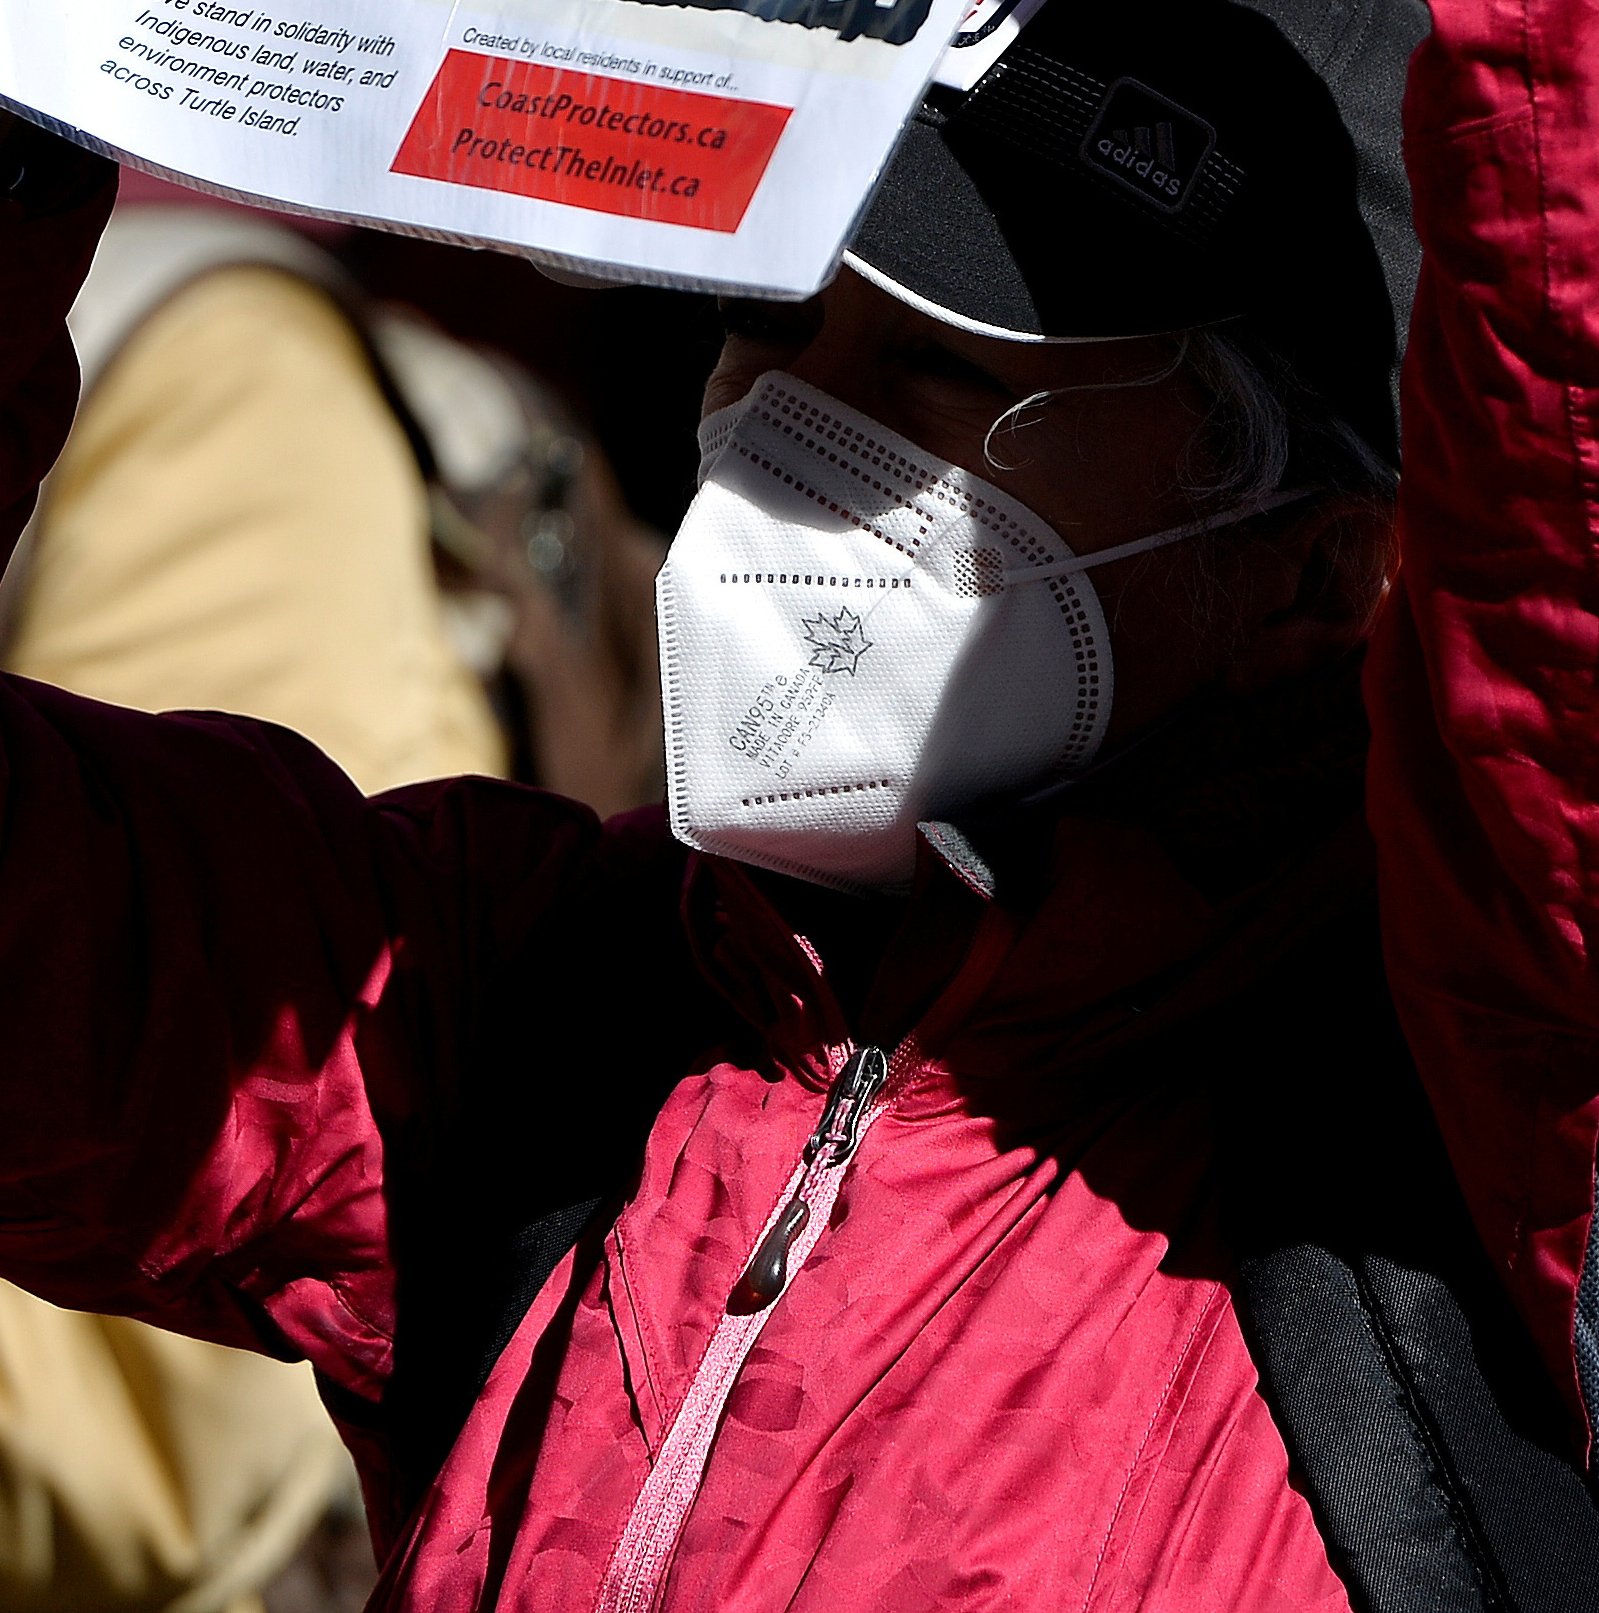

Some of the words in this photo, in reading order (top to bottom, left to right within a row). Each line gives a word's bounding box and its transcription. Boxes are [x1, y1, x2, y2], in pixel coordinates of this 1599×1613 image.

[135, 9, 250, 60] Indigenous
[250, 44, 297, 73] land,
[302, 57, 355, 85] water,
[359, 67, 400, 89] and
[192, 0, 252, 27] stand
[251, 12, 273, 33] in
[273, 18, 356, 54] solidarity
[356, 34, 397, 57] with
[462, 27, 521, 52] Created
[520, 37, 539, 58] by
[540, 41, 576, 61] local
[576, 49, 641, 74] residents
[642, 59, 658, 76] in
[658, 66, 714, 85] support
[100, 58, 174, 100] across
[177, 86, 238, 120] Turtle
[238, 105, 302, 136] Island.
[118, 36, 250, 91] environment
[244, 78, 345, 113] protectors
[477, 81, 729, 151] CoastProtectors.ca
[450, 127, 702, 198] ProtectTheInlet.ca
[1097, 139, 1181, 196] adidas
[746, 731, 770, 761] MADE
[768, 712, 783, 728] IN
[780, 667, 810, 710] CANADA
[759, 714, 800, 769] VITACORE
[775, 759, 793, 780] LOT
